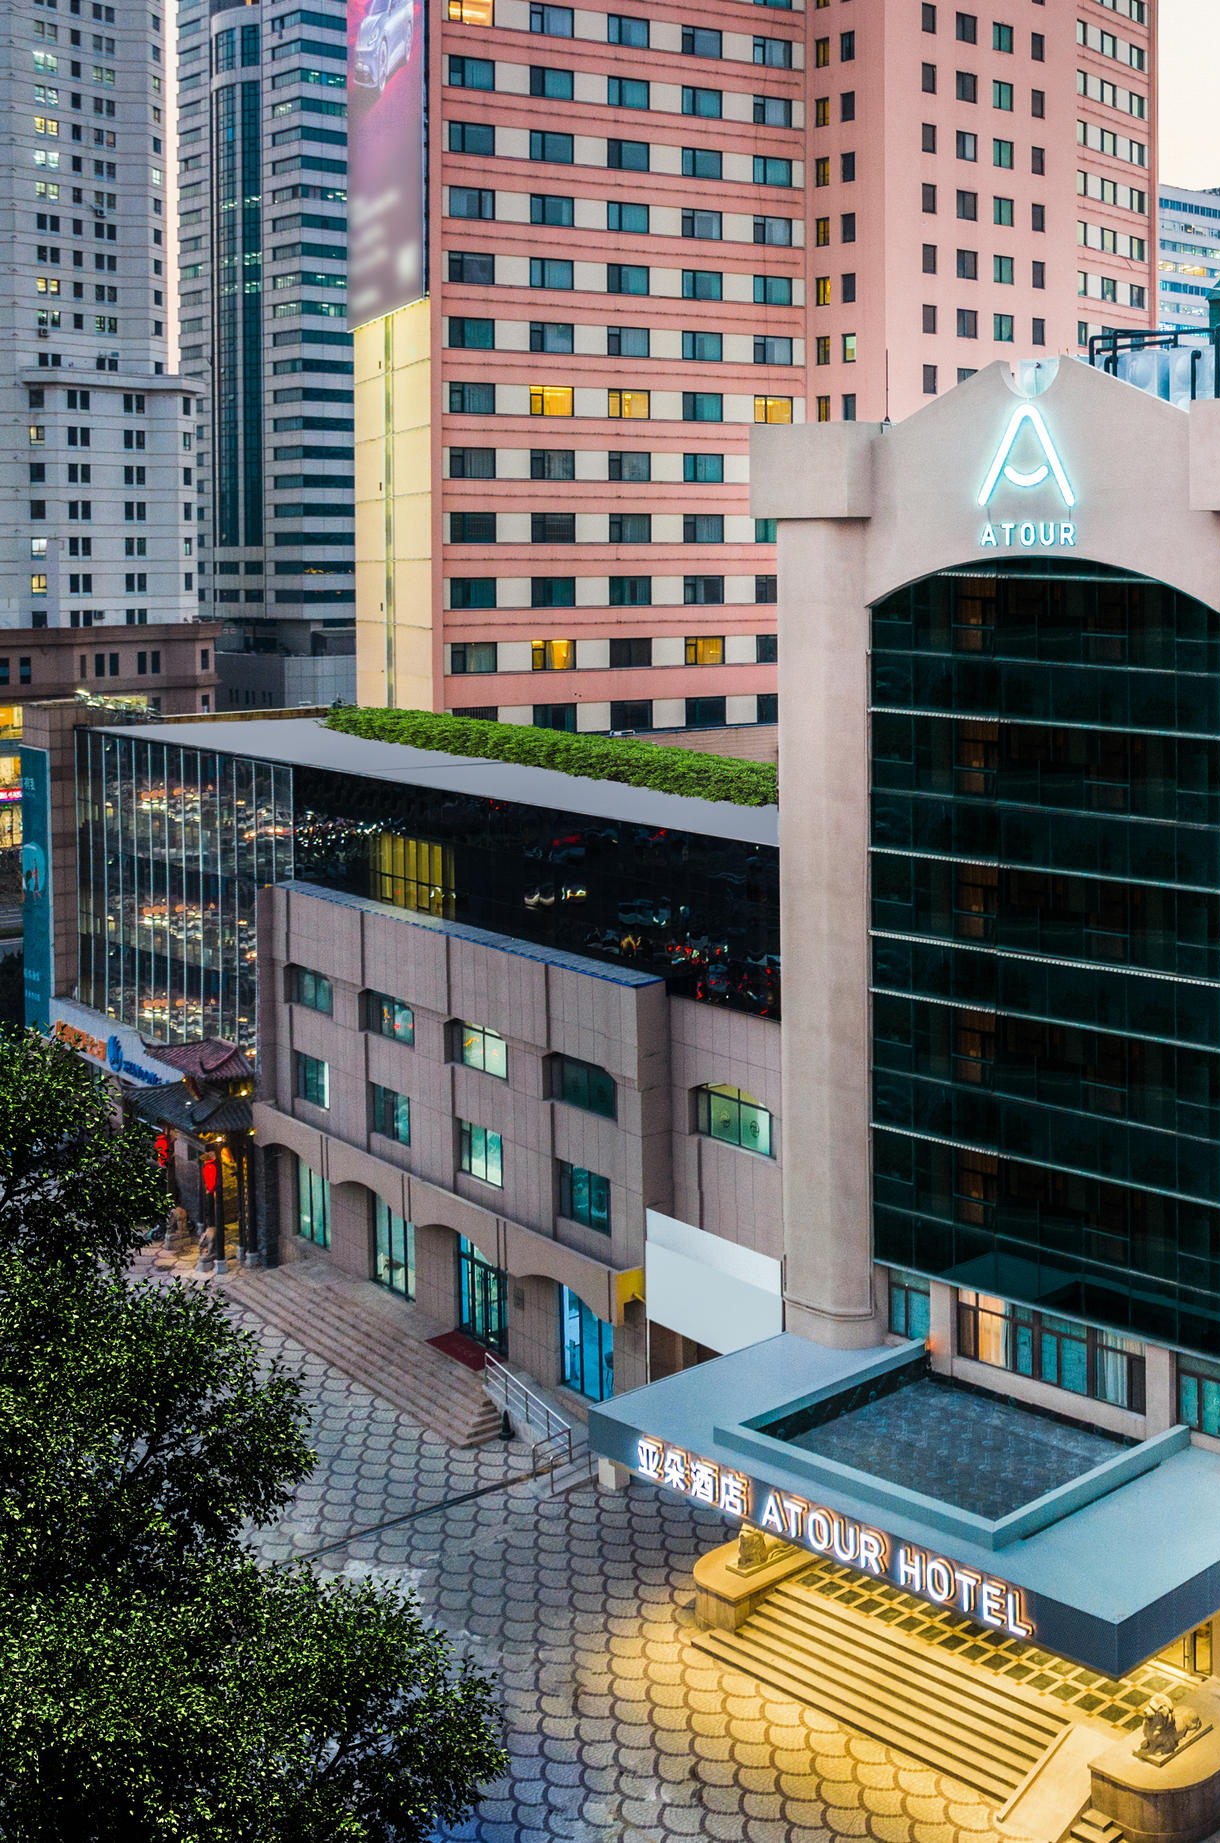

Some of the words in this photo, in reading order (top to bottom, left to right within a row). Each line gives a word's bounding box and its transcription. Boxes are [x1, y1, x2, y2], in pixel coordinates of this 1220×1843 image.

[980, 522, 1076, 548] ATOUR
[636, 1436, 749, 1516] 亚朵酒店
[762, 1492, 887, 1574] ATOUR
[899, 1547, 1034, 1638] HOTEL
